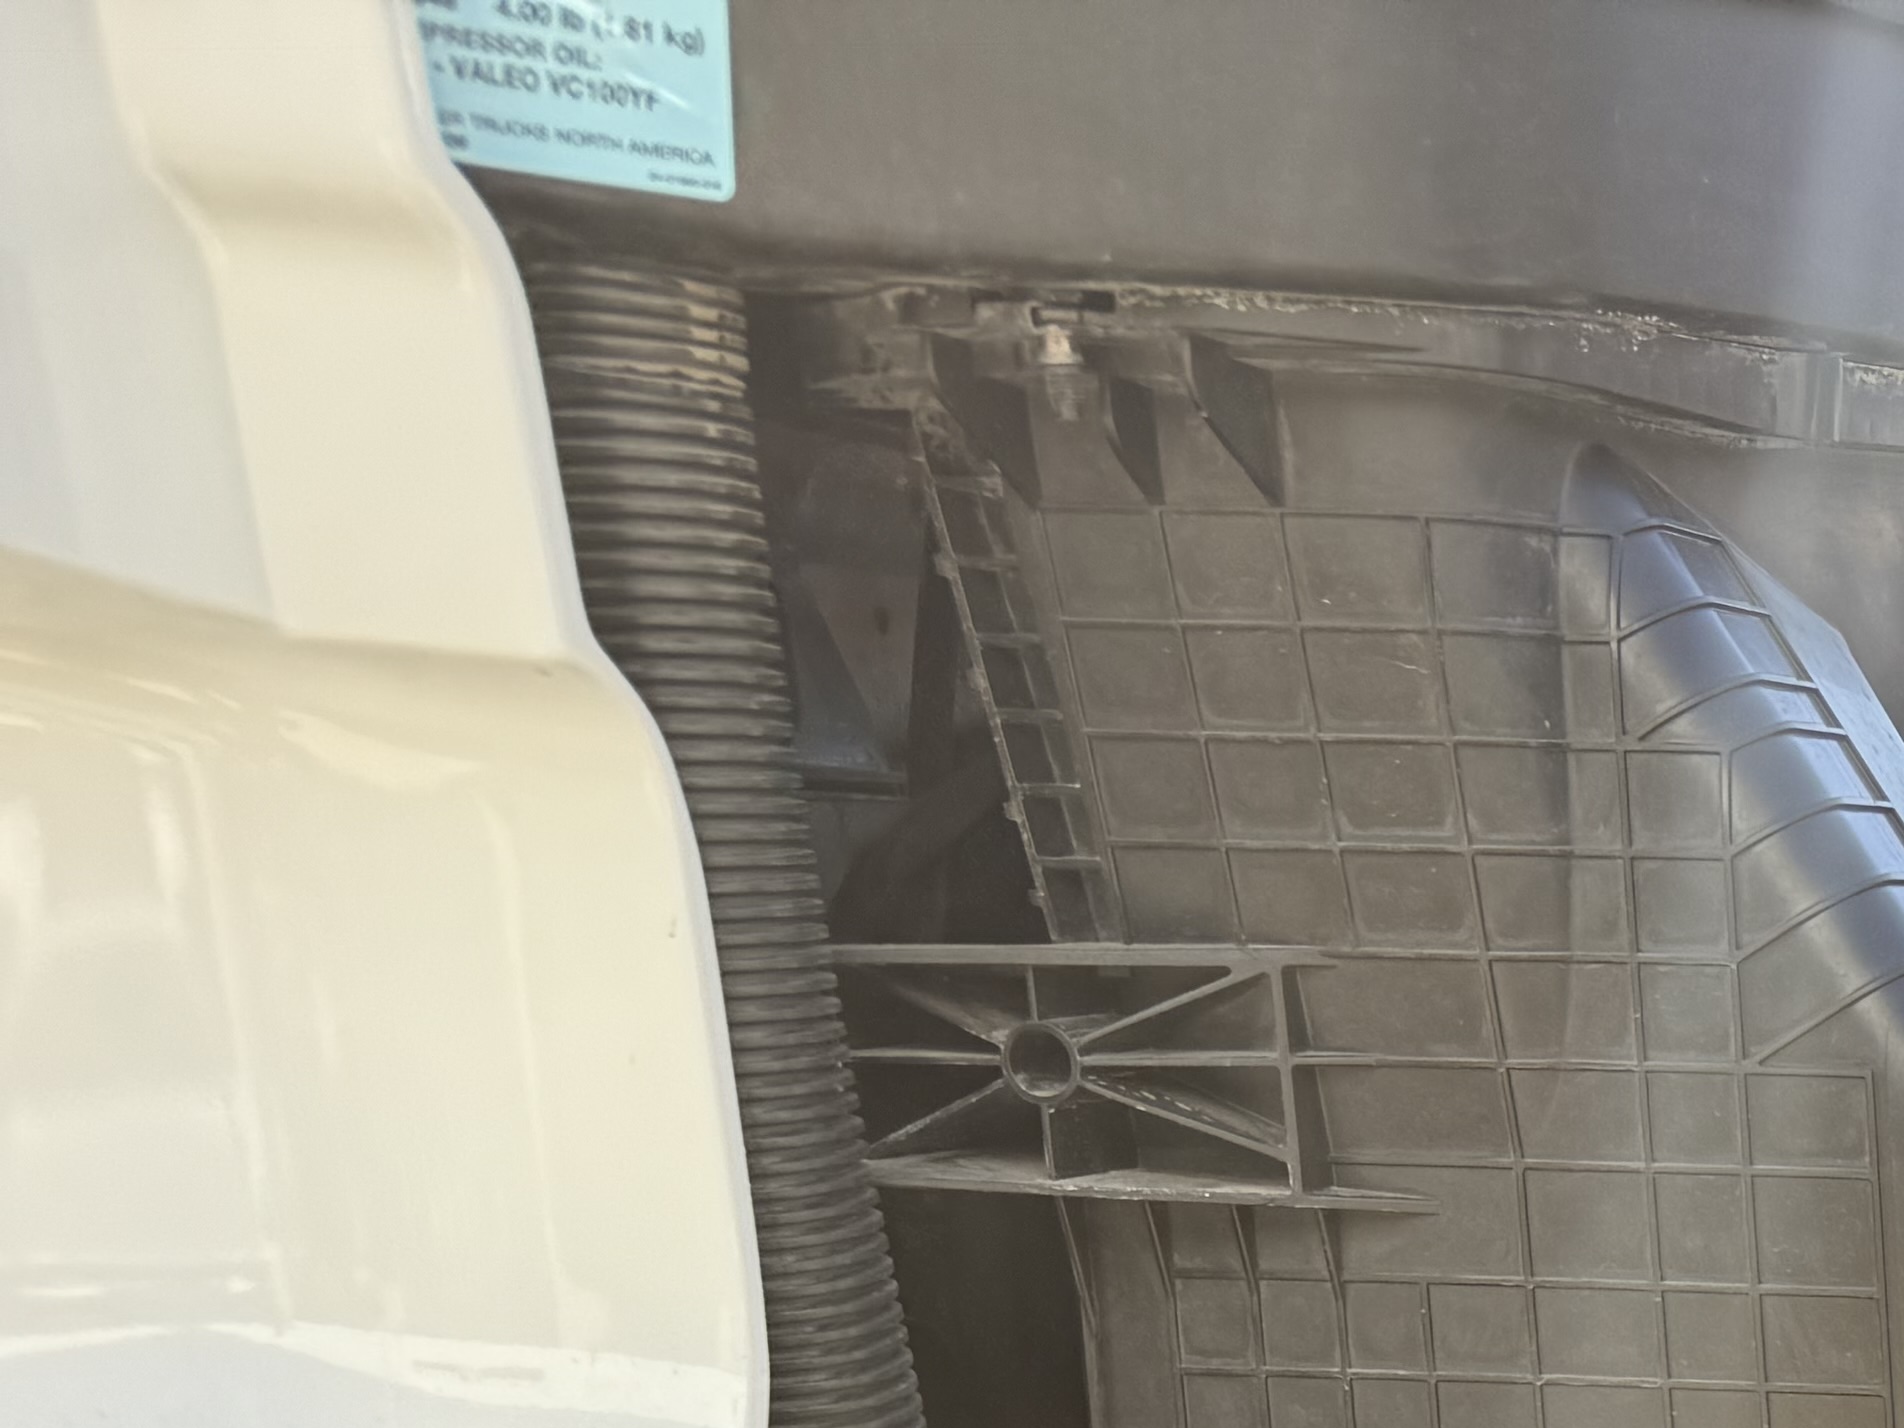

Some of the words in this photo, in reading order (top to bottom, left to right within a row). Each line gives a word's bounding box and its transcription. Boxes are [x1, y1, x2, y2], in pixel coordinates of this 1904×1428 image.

[418, 18, 547, 62] PRESSOR
[450, 54, 541, 92] VALEO
[469, 112, 550, 142] TRUCKS
[553, 126, 624, 152] NORTH
[628, 140, 716, 167] AMERICA
